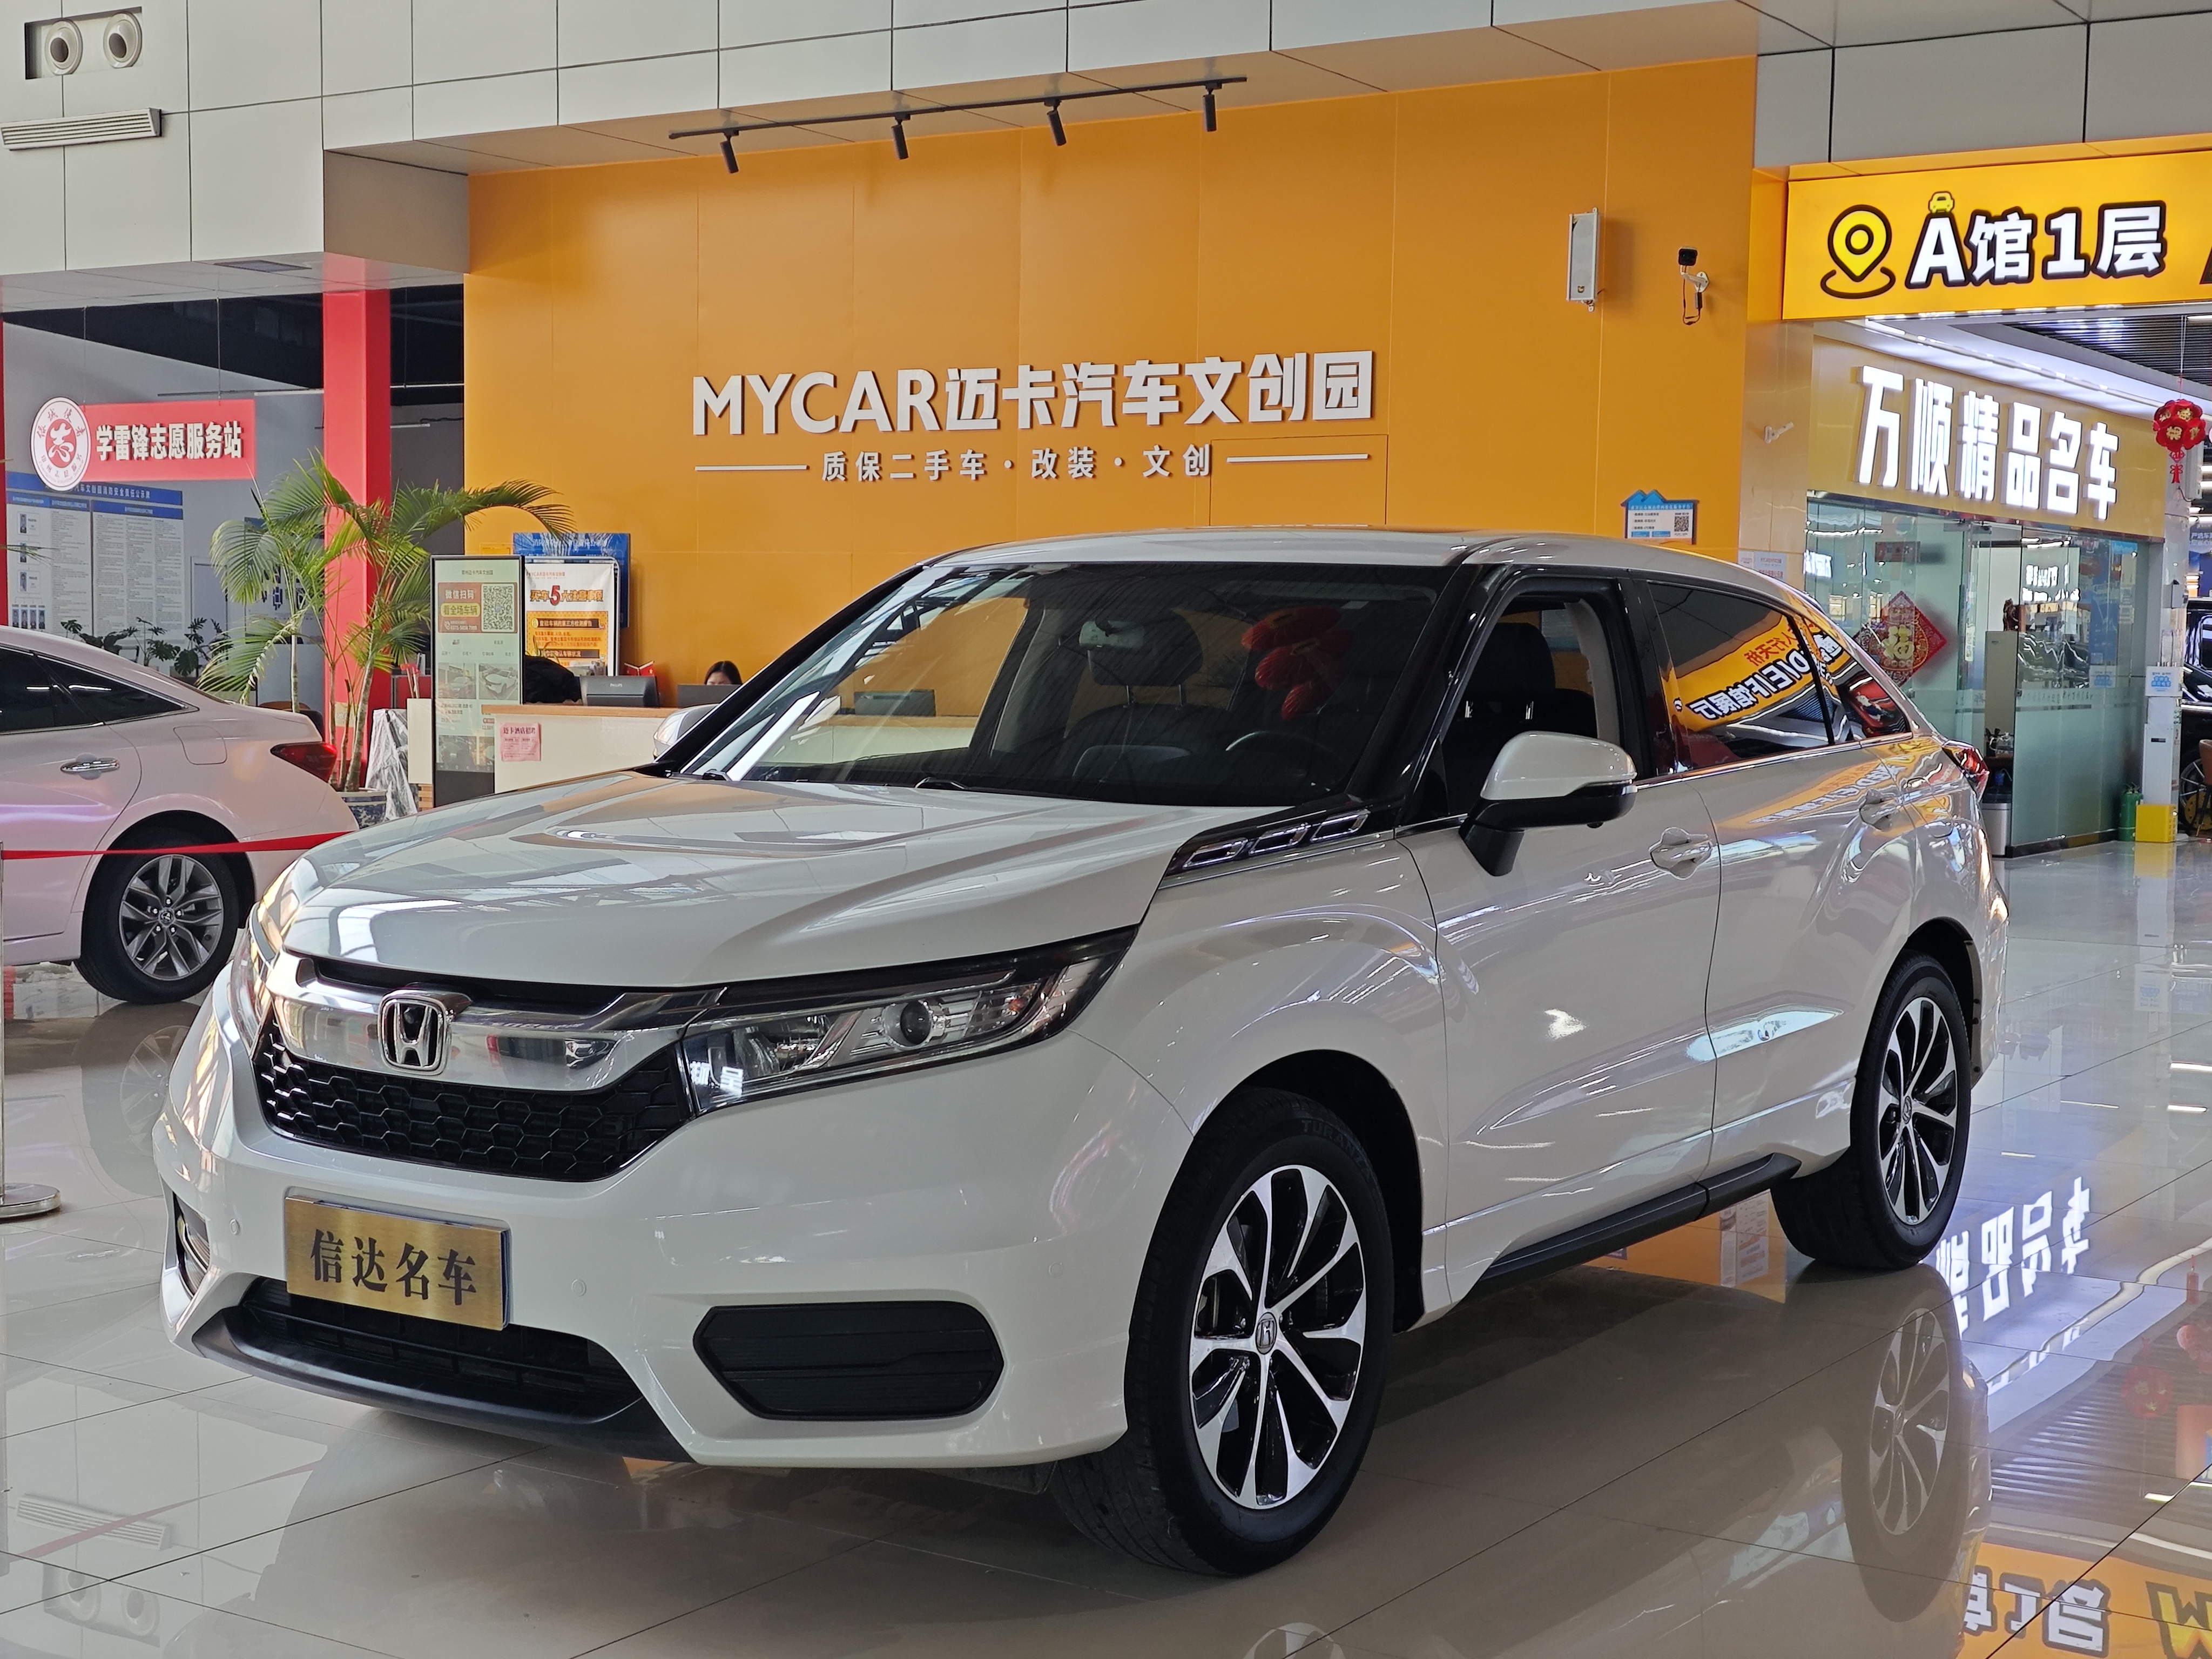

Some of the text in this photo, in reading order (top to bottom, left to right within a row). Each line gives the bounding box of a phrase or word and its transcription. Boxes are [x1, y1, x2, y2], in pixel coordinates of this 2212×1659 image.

[1906, 201, 2166, 288] A馆1层
[693, 350, 1375, 435] MYCAR迈卡汽车文创园
[96, 420, 244, 462] 学雷锋志愿服务站
[1857, 365, 2119, 520] 万顺精品名车
[444, 605, 478, 616] 看全场车辆
[445, 589, 474, 599] 微信扫码
[530, 585, 604, 606] 买车5大注意事项
[310, 1229, 477, 1306] 信达名车
